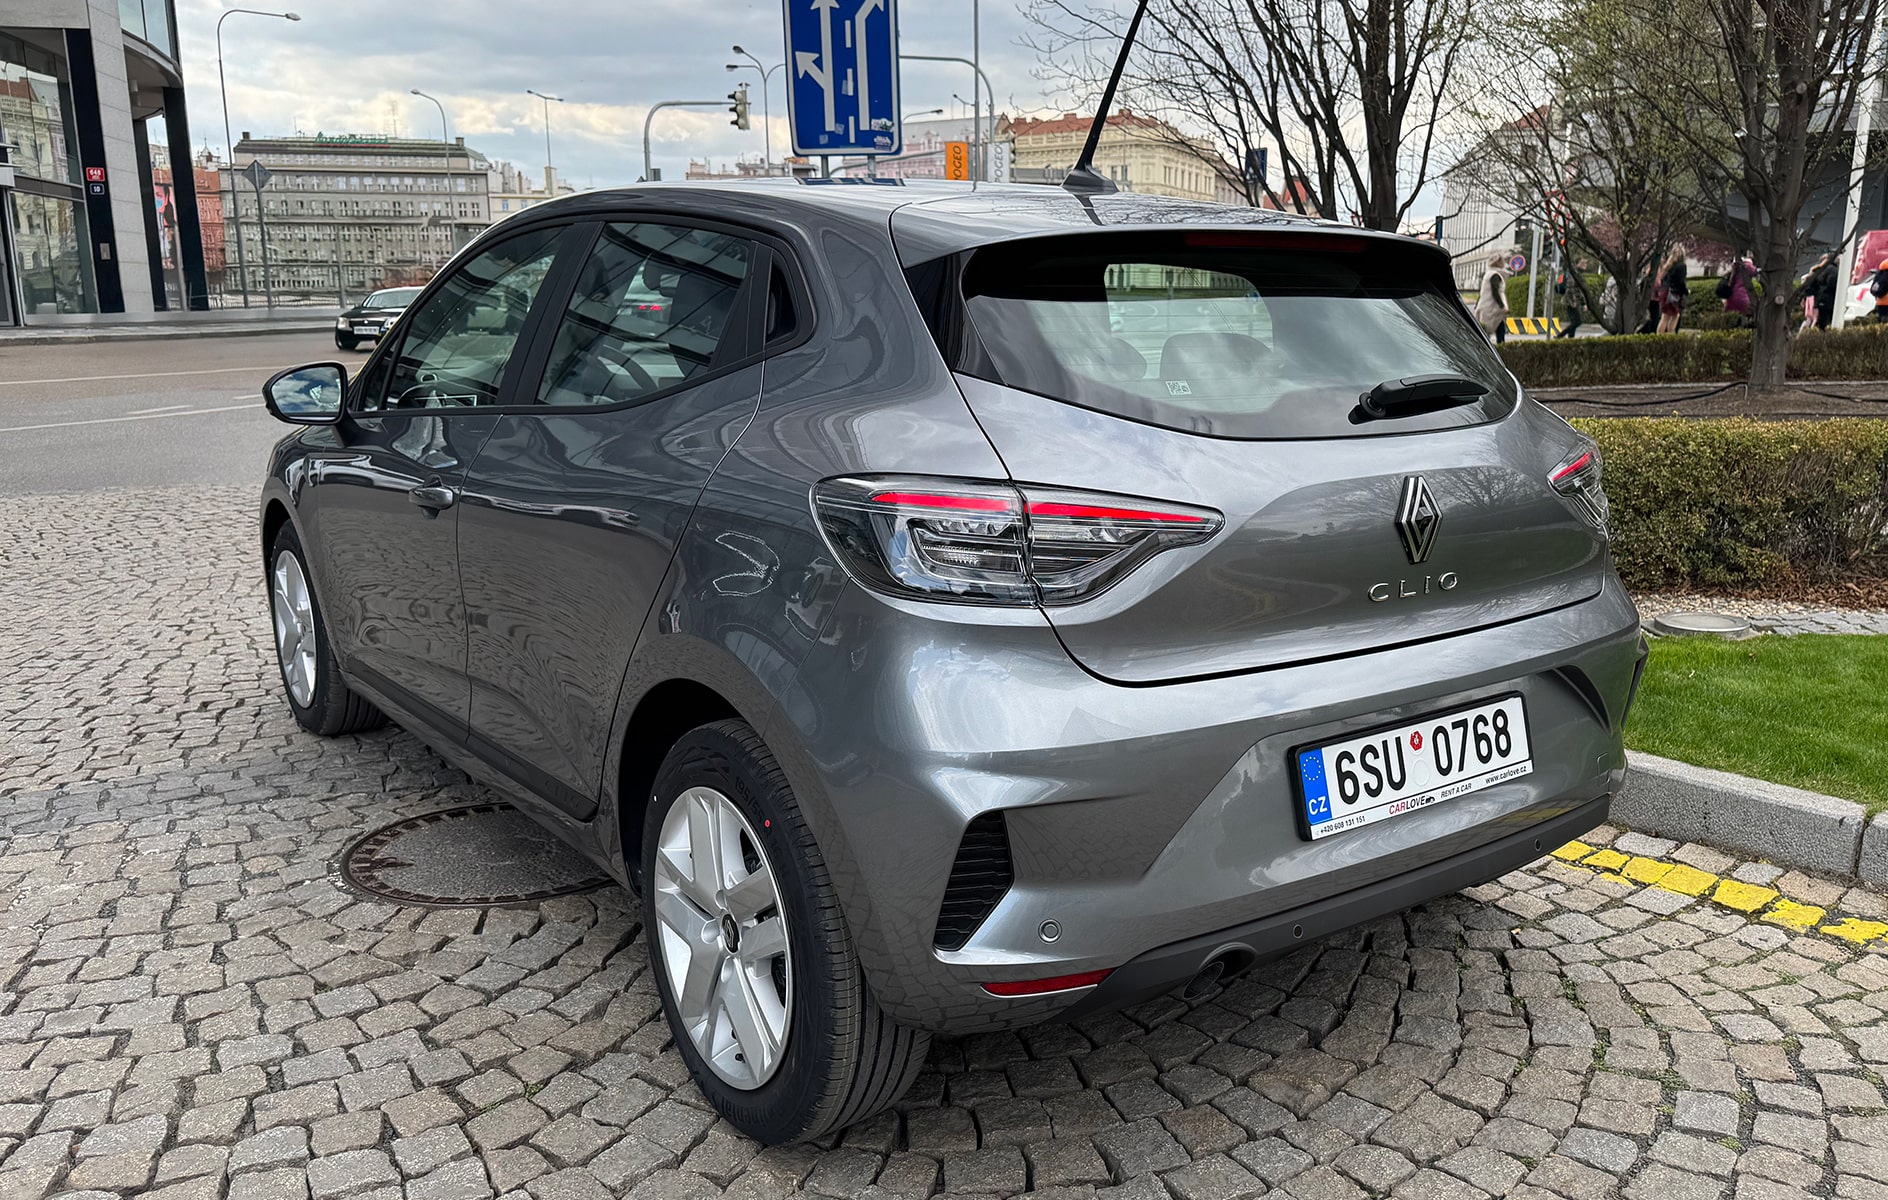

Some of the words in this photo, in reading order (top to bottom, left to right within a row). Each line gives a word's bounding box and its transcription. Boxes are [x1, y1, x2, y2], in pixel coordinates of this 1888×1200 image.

[1368, 571, 1458, 602] CLIO
[1335, 735, 1406, 805] 6SU
[1432, 708, 1511, 776] 0768
[1485, 765, 1527, 784] www.carlove.cz
[1440, 787, 1454, 799] RENT
[1460, 783, 1472, 792] CAR
[1308, 795, 1328, 816] CZ
[1388, 796, 1426, 815] CARLOVE
[1320, 824, 1334, 833] +420
[1334, 821, 1344, 830] 608
[1345, 818, 1354, 826] 131
[1356, 815, 1366, 824] 151
